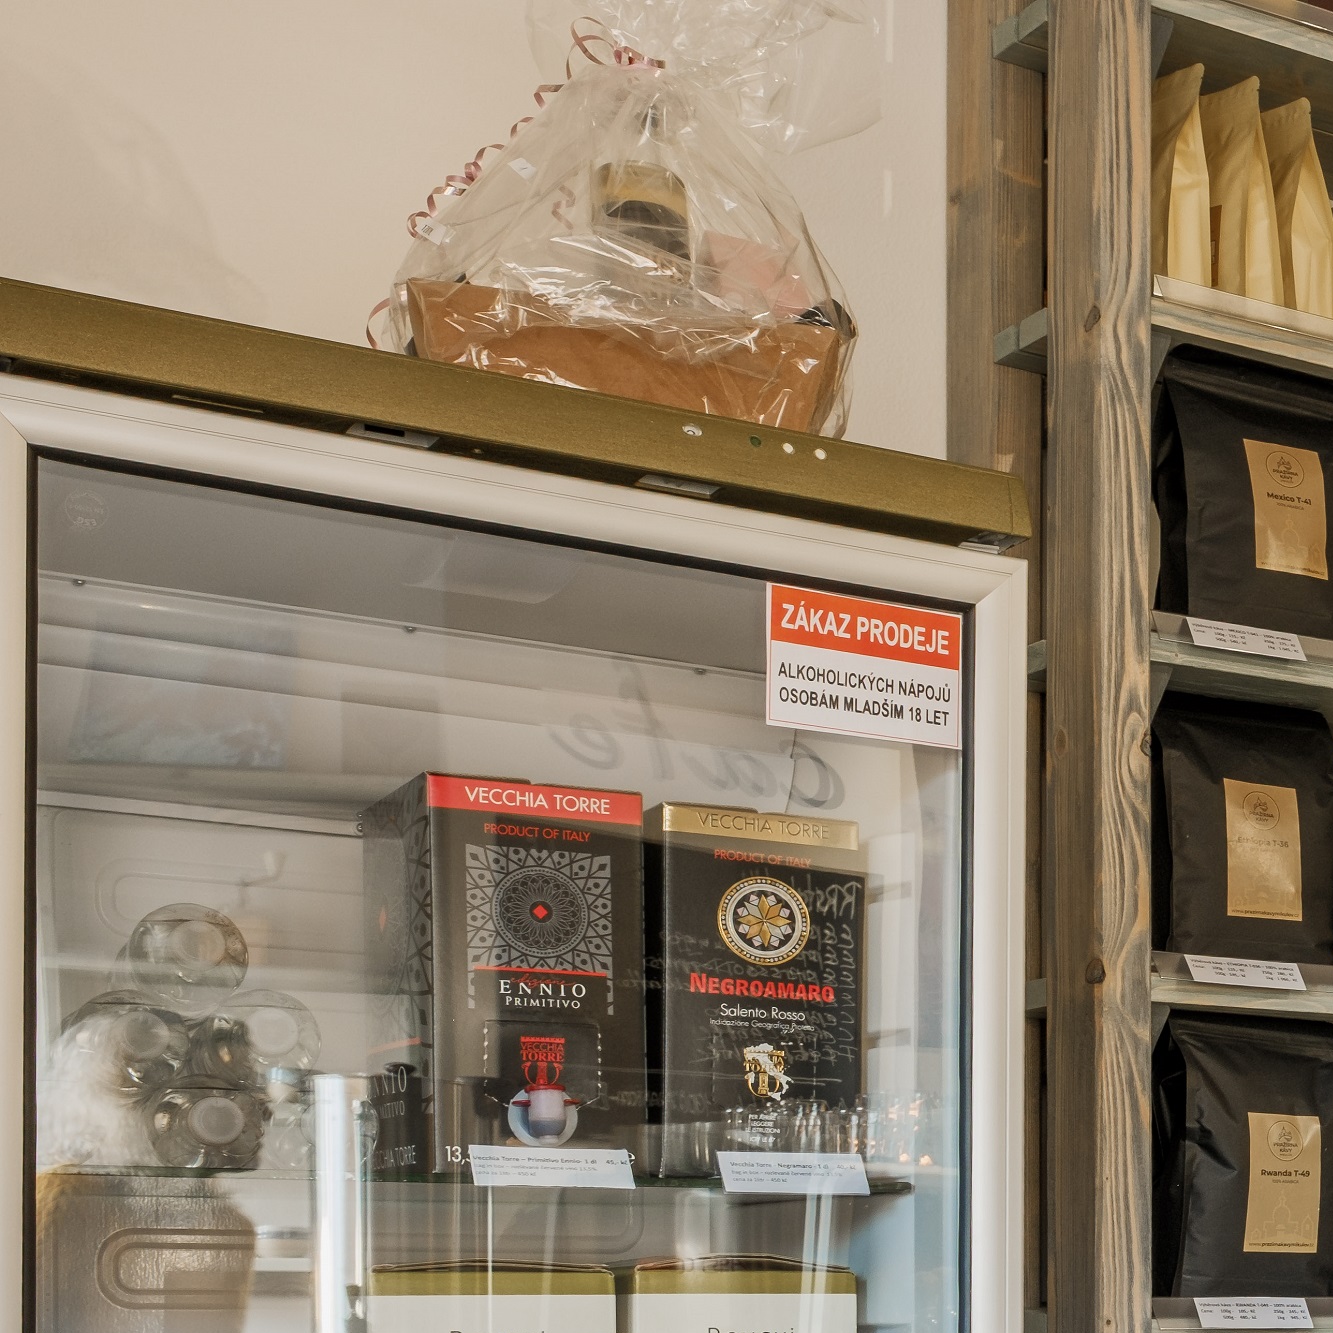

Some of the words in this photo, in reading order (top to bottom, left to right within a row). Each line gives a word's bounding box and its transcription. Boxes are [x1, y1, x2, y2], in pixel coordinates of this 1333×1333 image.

[1266, 492, 1295, 502] Mexico
[781, 601, 850, 639] ZÁKAZ
[857, 617, 949, 655] PRODEJE
[778, 662, 894, 694] ALKOHOLICKÝCH
[899, 679, 950, 702] NÁPOJŮ
[779, 687, 839, 710] OSOBÁM
[844, 697, 904, 720] MLADŠÍM
[909, 707, 921, 722] 18
[926, 709, 949, 726] LET
[465, 786, 548, 809] VECCHIA
[554, 794, 610, 815] TORRE
[484, 823, 539, 838] PRODUCT
[543, 828, 559, 839] OF
[563, 830, 590, 842] ITALY
[697, 812, 773, 833] VECCHIA
[779, 820, 829, 839] TORRE
[714, 850, 765, 864] PRODUCT
[768, 854, 782, 864] OF
[786, 856, 812, 867] ITALY
[499, 980, 586, 997] ENNIO
[690, 973, 835, 1002] NEGROAMARO
[505, 996, 581, 1009] PRIMITIVO
[720, 1003, 767, 1019] Salento
[772, 1007, 805, 1021] Rosso
[751, 1020, 789, 1030] Geografica
[521, 1043, 564, 1051] VECCHIA
[522, 1051, 564, 1062] TORRE
[445, 1146, 470, 1164] 13,
